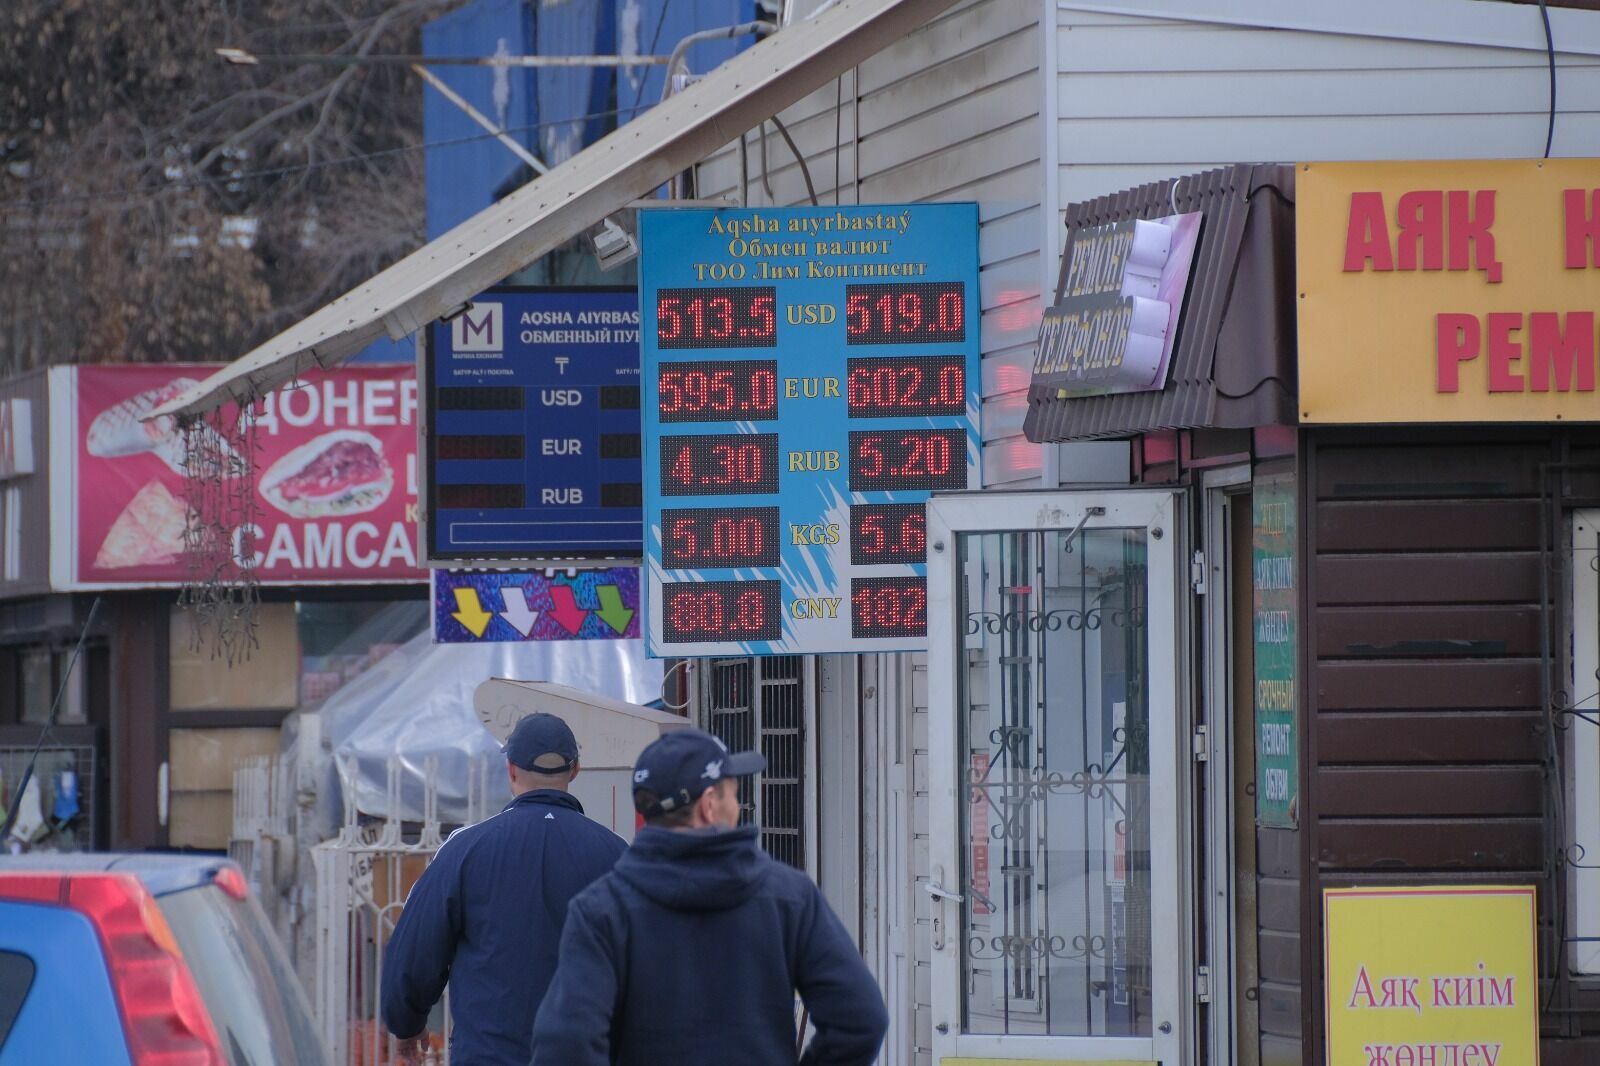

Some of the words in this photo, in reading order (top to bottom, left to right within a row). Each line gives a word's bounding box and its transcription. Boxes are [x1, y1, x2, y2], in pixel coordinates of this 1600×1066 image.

[708, 214, 780, 238] Aqsha
[1342, 190, 1503, 283] АЯҚ
[728, 237, 807, 258] Обмен
[815, 239, 891, 256] валют
[693, 263, 745, 281] ТОО
[752, 263, 801, 280] Лим
[807, 261, 928, 279] Континент
[462, 309, 493, 345] M
[520, 311, 573, 325] AQSHA
[576, 311, 640, 324] AIYRBAS
[657, 297, 776, 339] 513.5
[785, 304, 836, 325] USD
[847, 292, 962, 334] 519.0
[520, 328, 611, 343] ОБМЕННЫЙ
[1436, 312, 1594, 393] РЕМ
[541, 390, 582, 406] USD
[659, 369, 775, 413] 595.0
[784, 377, 841, 399] EUR
[848, 366, 964, 408] 602.0
[541, 439, 582, 455] EUR
[672, 444, 762, 485] 4.30
[788, 450, 841, 472] RUB
[860, 435, 950, 477] 5.20
[541, 488, 583, 504] RUB
[232, 521, 416, 569] САМСА
[672, 518, 762, 558] 5.00
[791, 523, 840, 546] KGS
[791, 597, 842, 619] CNY
[1259, 674, 1293, 712] СРОЧНЫЙ
[1262, 723, 1290, 755] РЕМОНТ
[1265, 768, 1288, 800] ОБУВИ
[1348, 965, 1421, 1014] Аяқ
[1431, 962, 1515, 1008] киім
